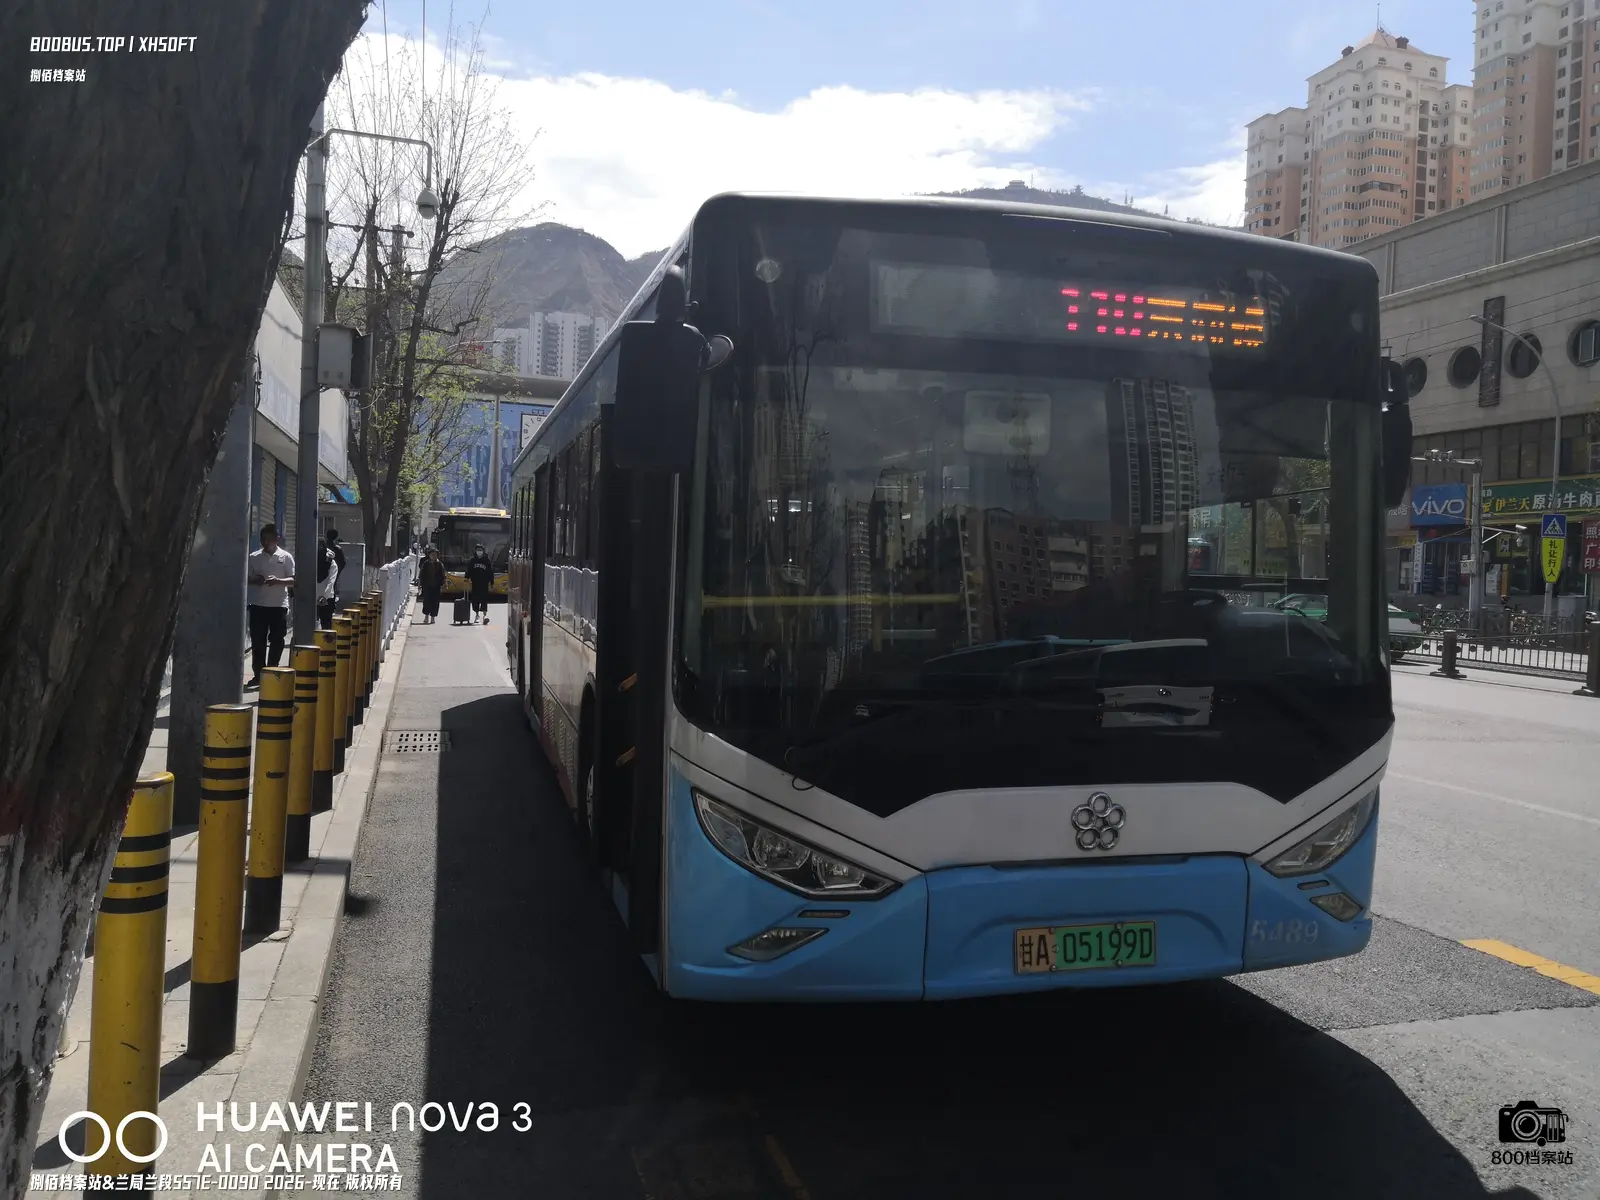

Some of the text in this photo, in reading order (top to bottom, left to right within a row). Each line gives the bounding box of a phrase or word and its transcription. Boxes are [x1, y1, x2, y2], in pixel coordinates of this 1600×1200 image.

[1411, 495, 1466, 516] vivo
[1586, 525, 1600, 539] 照
[1585, 541, 1600, 556] 广
[1547, 539, 1558, 577] 礼让行人
[1584, 557, 1600, 571] 印
